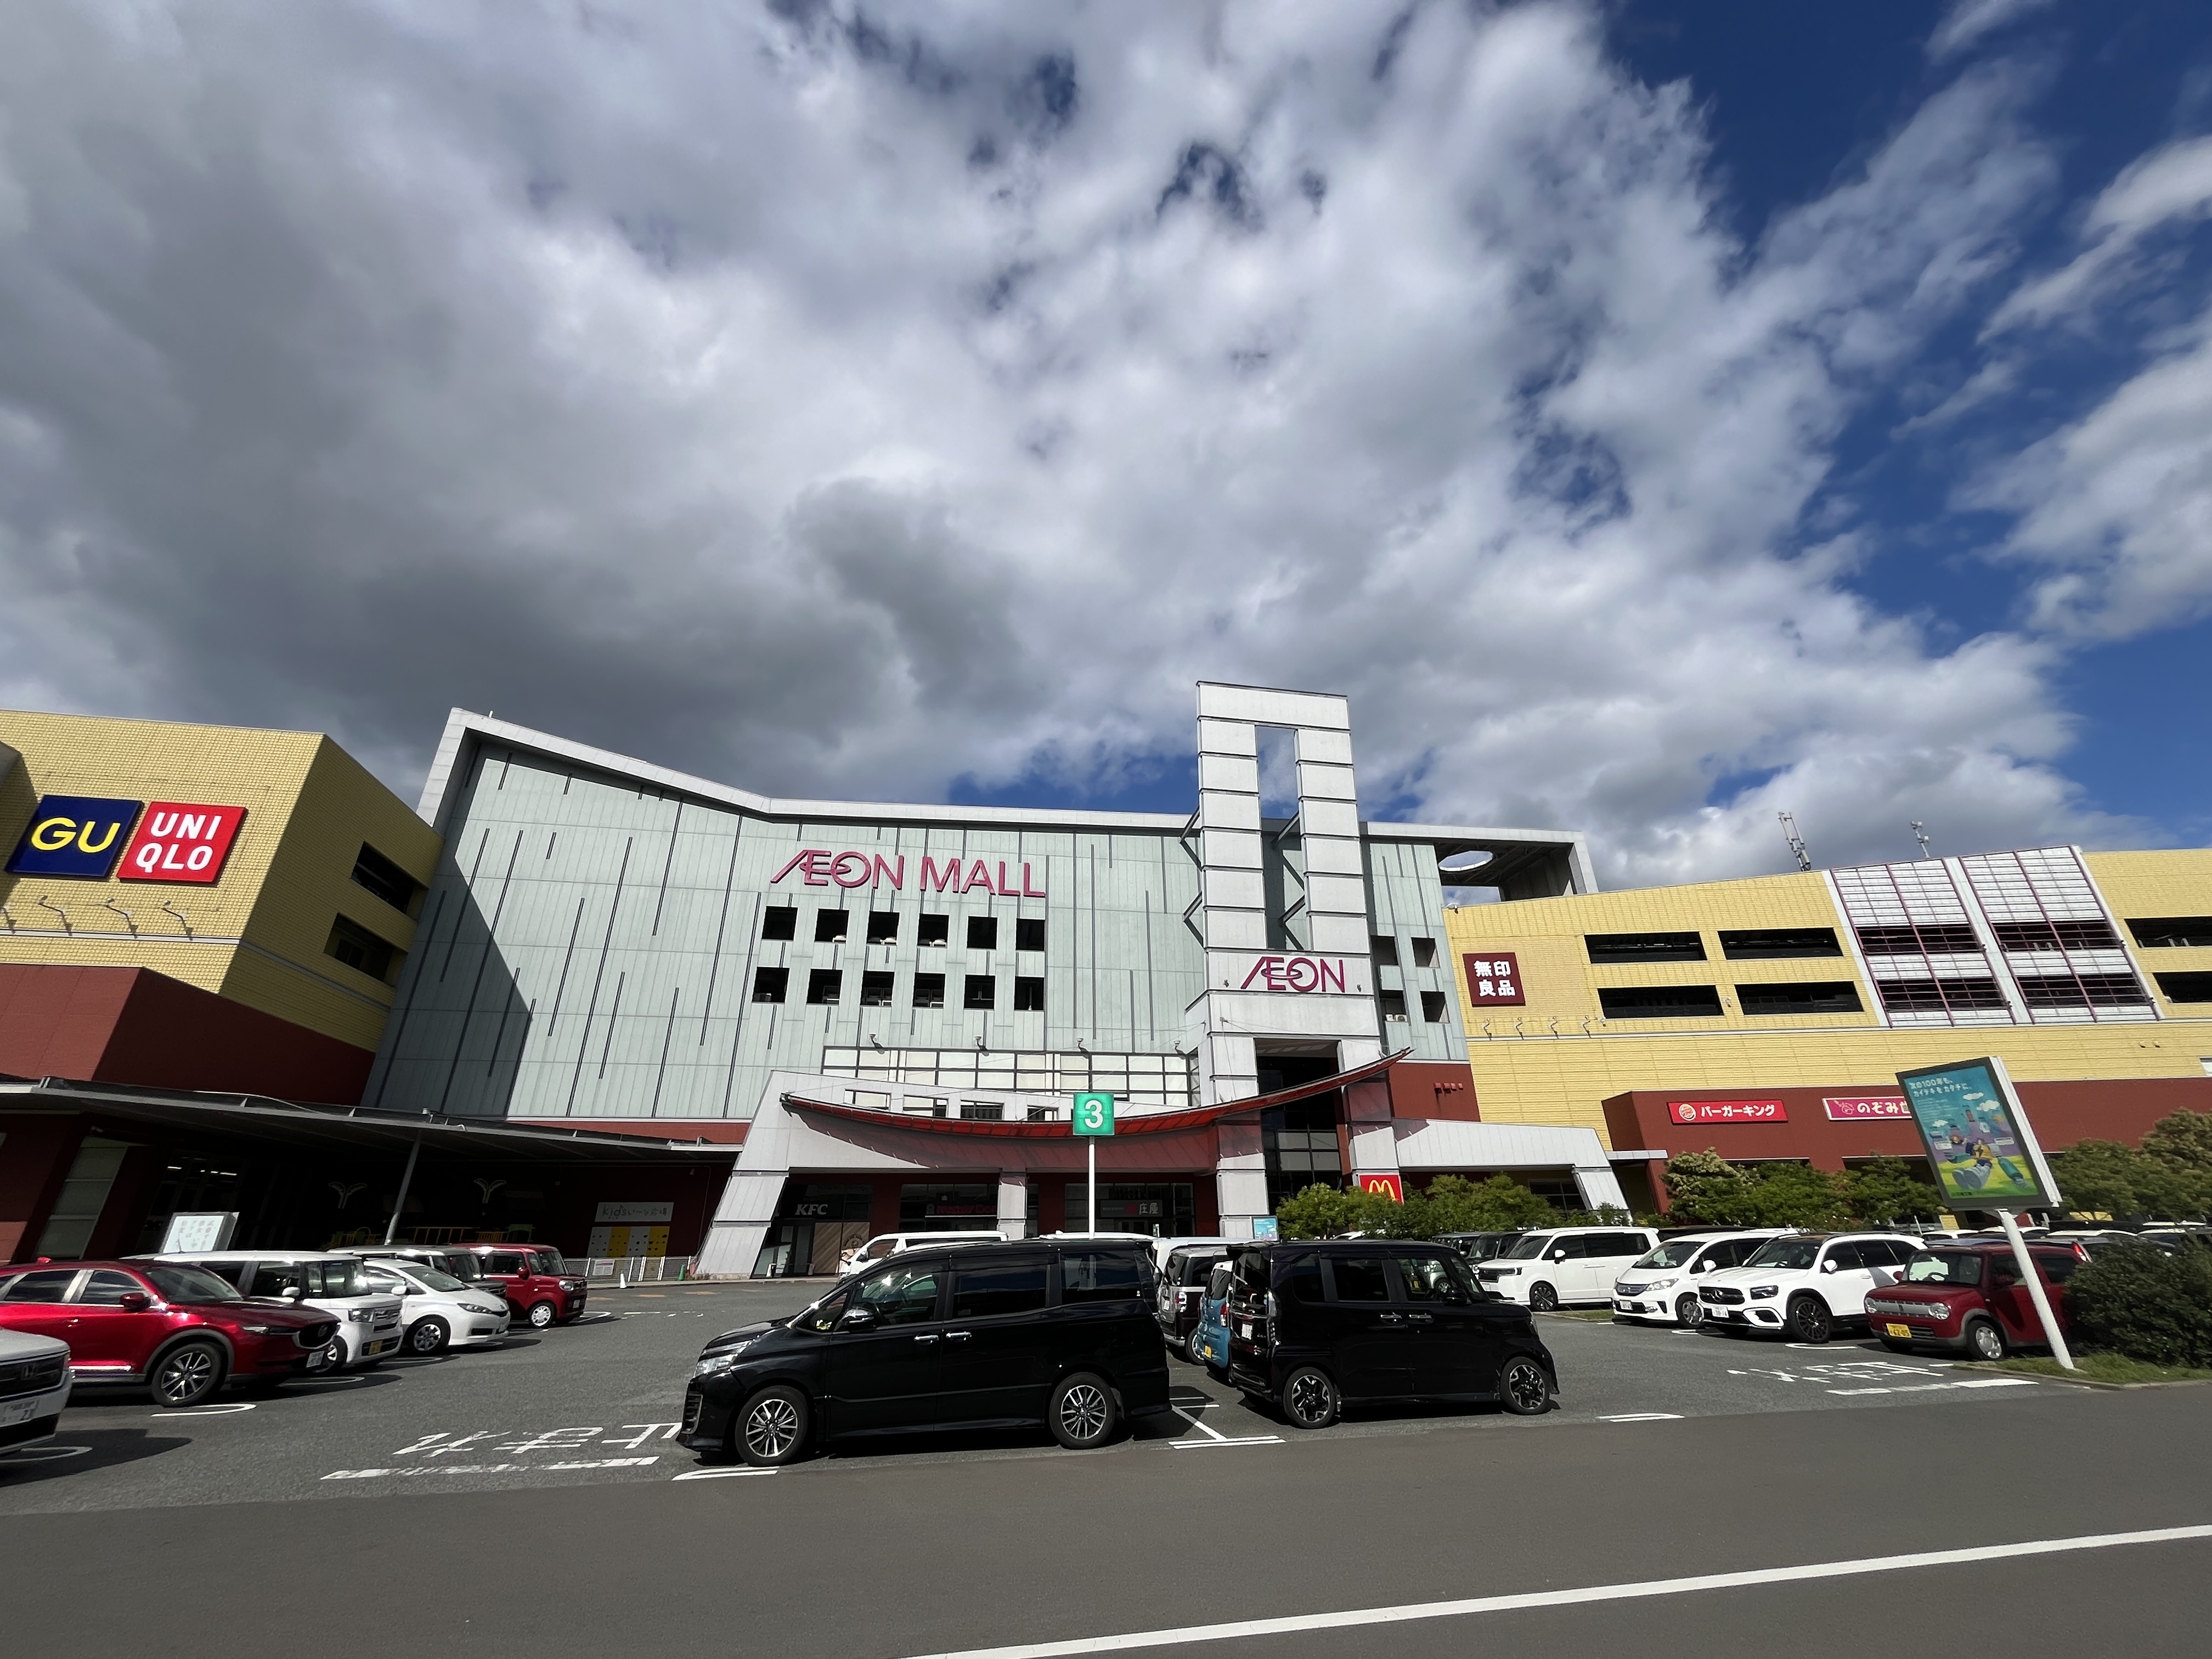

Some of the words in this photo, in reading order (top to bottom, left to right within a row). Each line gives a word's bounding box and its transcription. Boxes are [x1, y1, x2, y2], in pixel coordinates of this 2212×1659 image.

[31, 817, 121, 853] GU
[150, 811, 222, 840] UNI
[135, 843, 213, 873] QLO
[919, 856, 1046, 898] MALL
[1474, 960, 1511, 977] 無印
[1479, 979, 1515, 997] 良品
[1084, 1099, 1104, 1129] 3
[1701, 1104, 1775, 1117] バーガーキング
[794, 1204, 828, 1215] KFC
